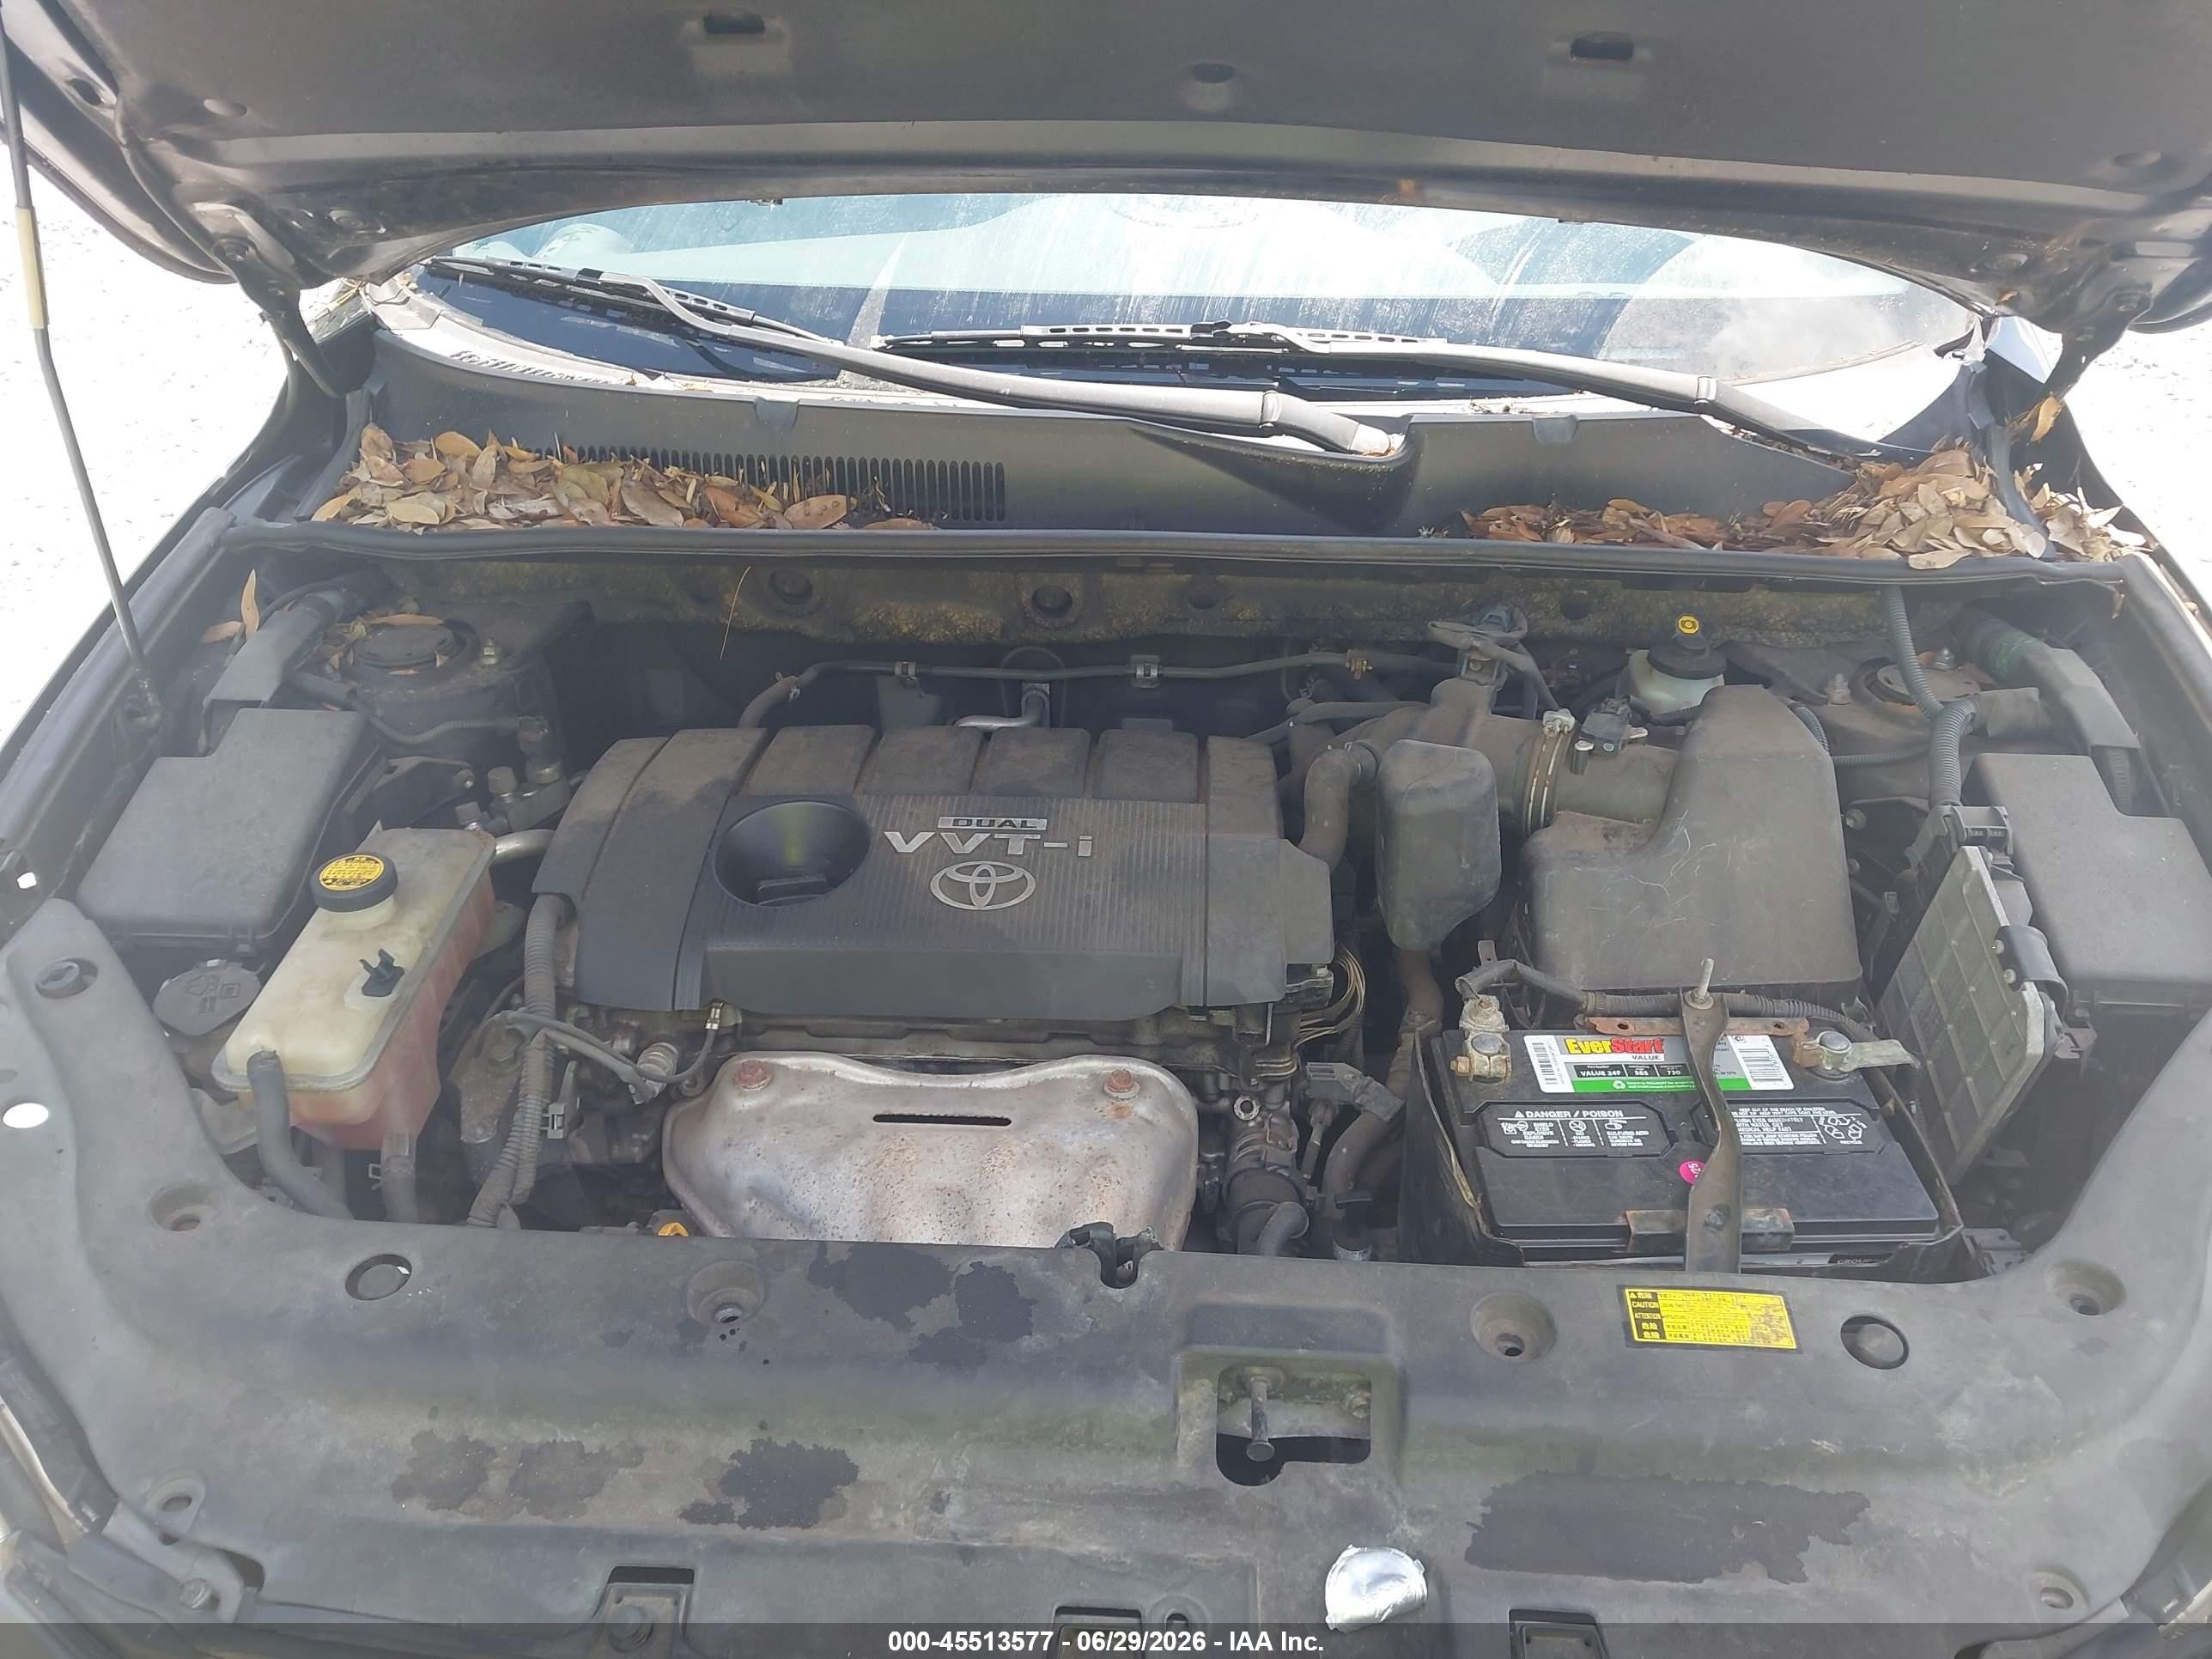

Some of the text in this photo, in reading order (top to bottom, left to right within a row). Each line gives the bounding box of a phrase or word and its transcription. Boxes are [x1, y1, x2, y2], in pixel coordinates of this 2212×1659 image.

[947, 817, 1041, 829] DUAL
[884, 831, 1093, 857] VVT-i
[1565, 1037, 1664, 1054] EverStart
